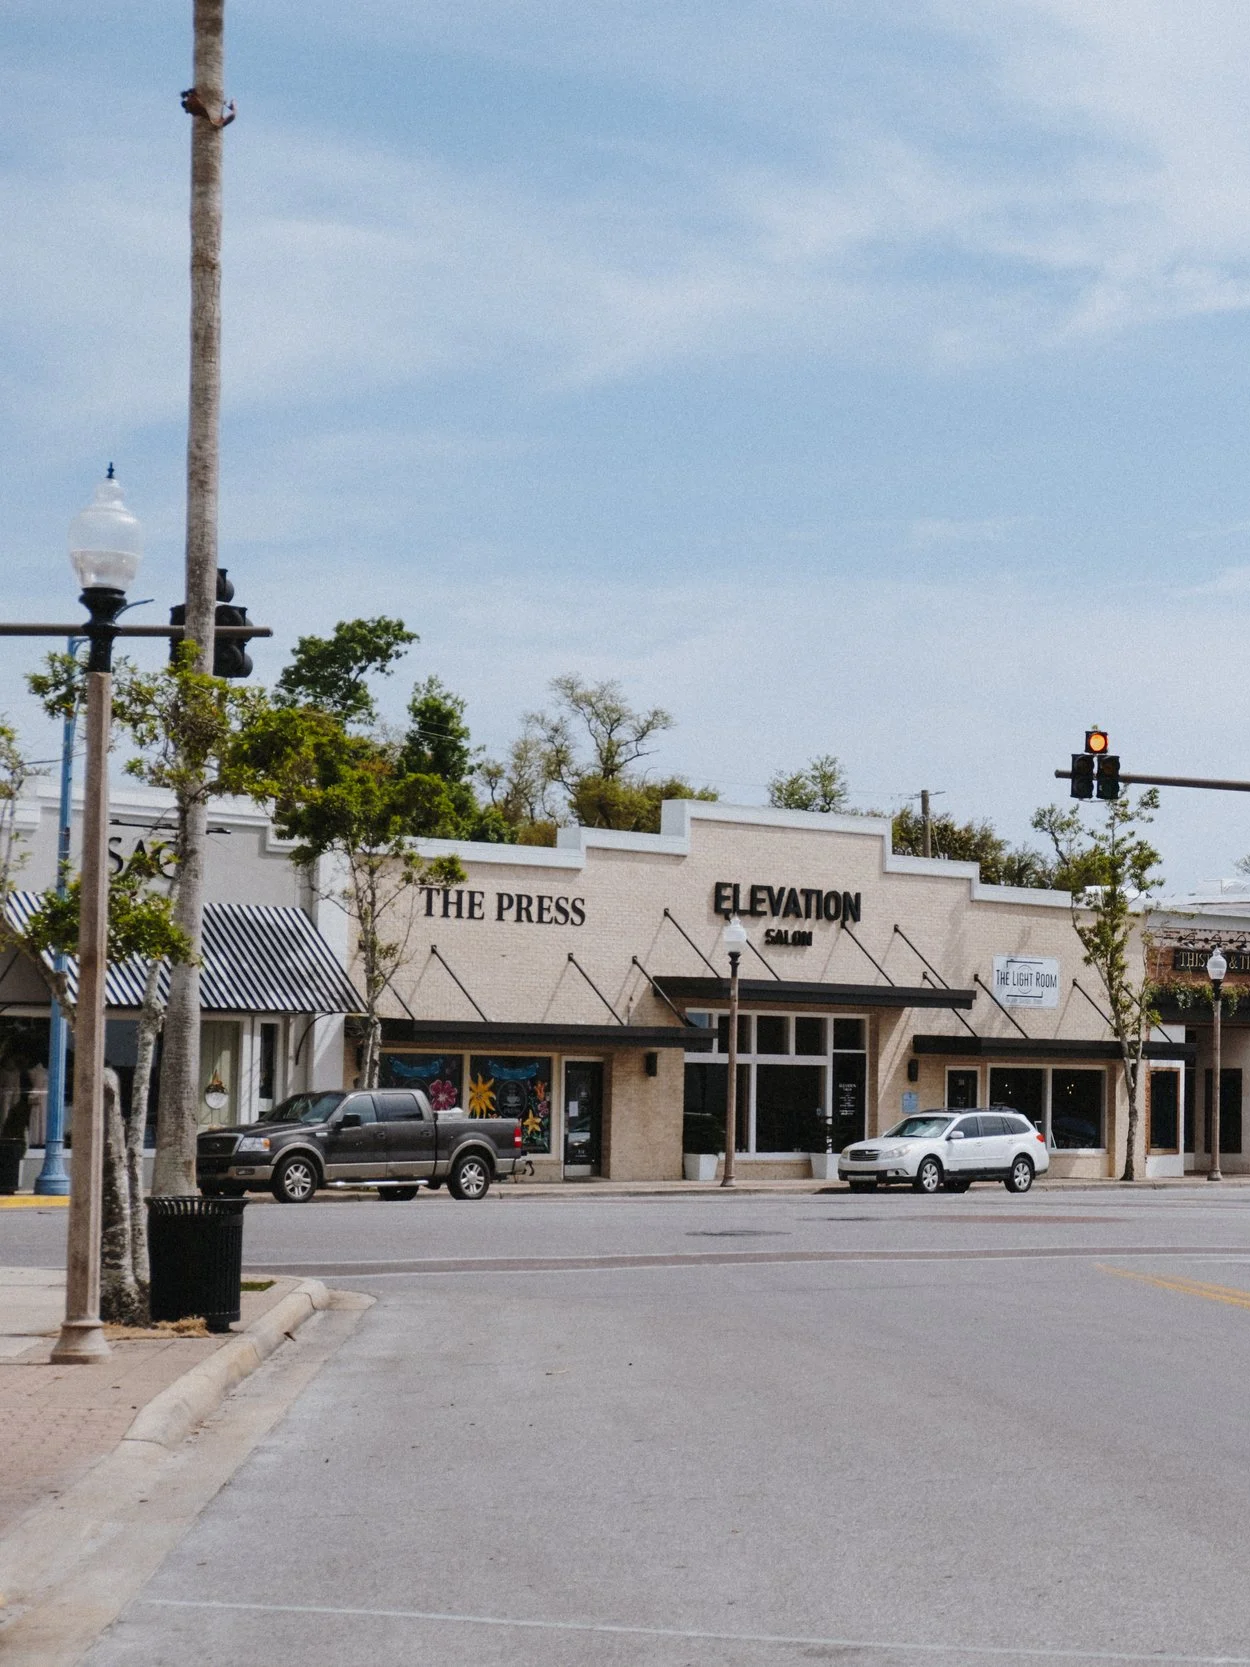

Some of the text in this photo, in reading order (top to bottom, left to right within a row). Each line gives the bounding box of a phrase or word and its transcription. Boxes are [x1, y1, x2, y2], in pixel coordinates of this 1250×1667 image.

[419, 887, 586, 926] THE PRESS
[714, 882, 861, 922] ELEVATION
[764, 928, 813, 946] SALON
[1228, 955, 1238, 969] &
[996, 969, 1057, 988] THE LIGHT ROOM
